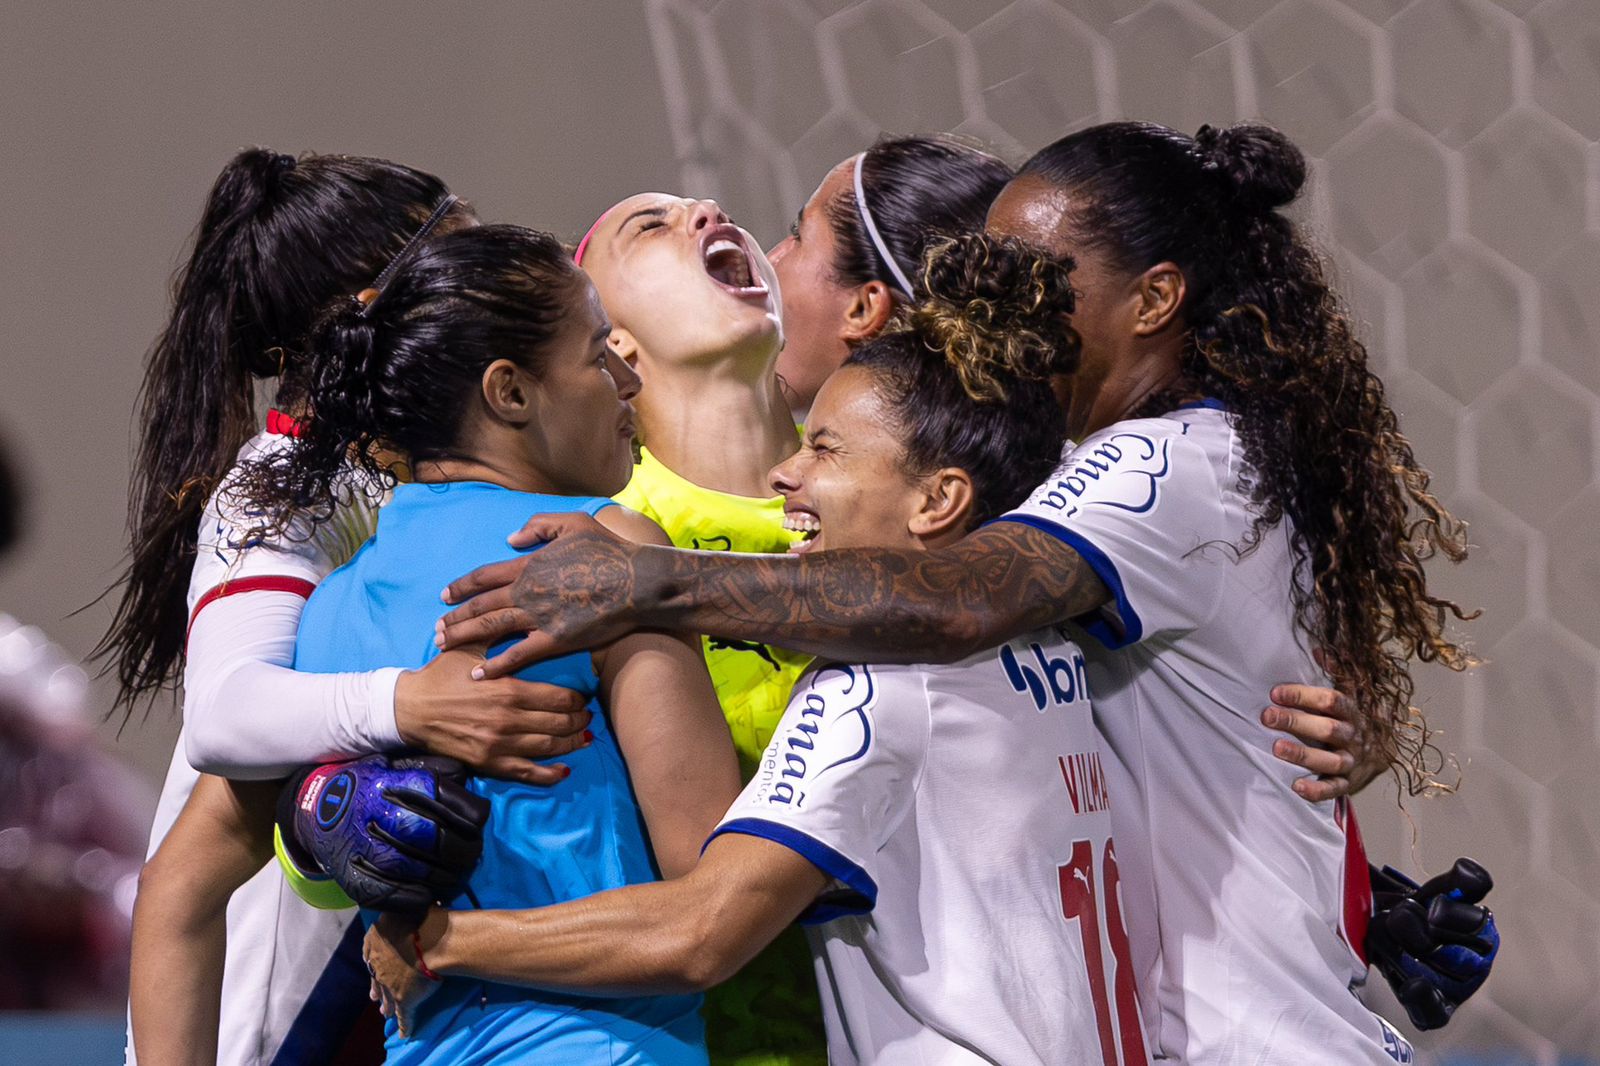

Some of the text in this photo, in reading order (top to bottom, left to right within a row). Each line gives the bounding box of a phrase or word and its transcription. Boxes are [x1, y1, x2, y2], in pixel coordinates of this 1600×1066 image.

[1040, 434, 1155, 518] Canaã
[769, 662, 856, 808] Canaã
[753, 742, 780, 803] mento
[1058, 751, 1111, 814] VILMA
